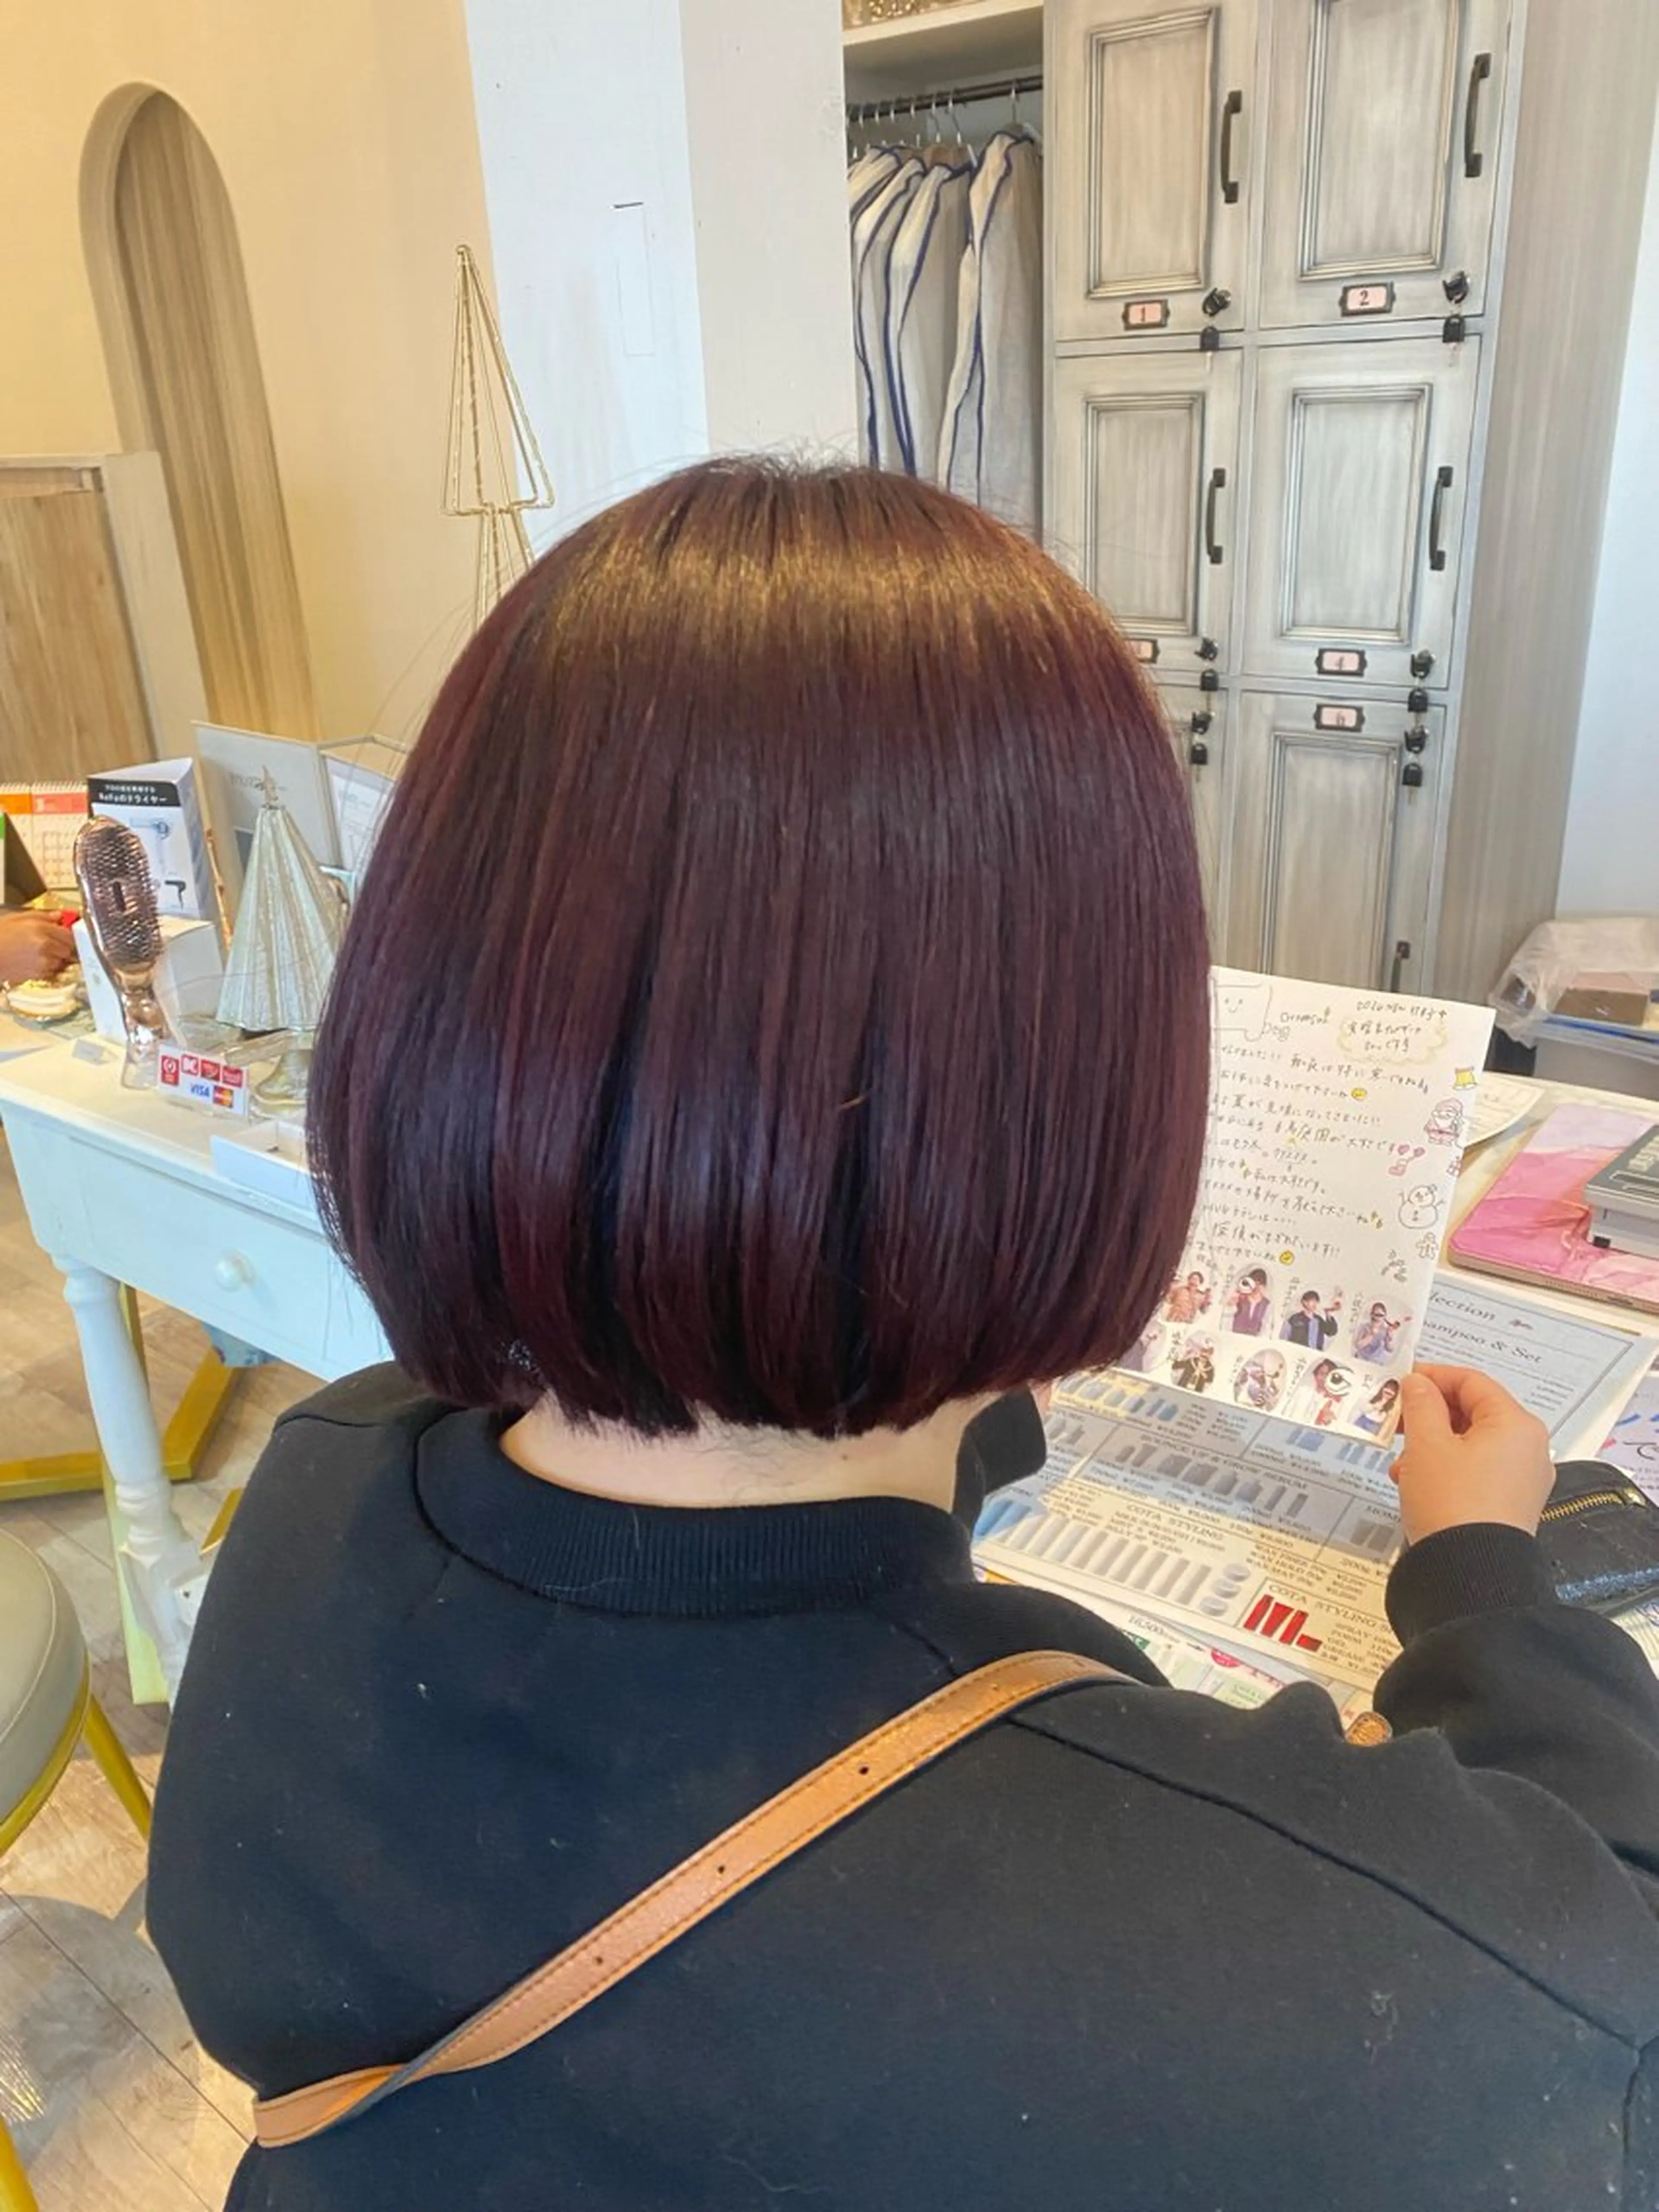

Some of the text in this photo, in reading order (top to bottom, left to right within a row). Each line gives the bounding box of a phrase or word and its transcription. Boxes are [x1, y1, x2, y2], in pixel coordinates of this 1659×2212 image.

[1360, 289, 1370, 306] 2
[1140, 306, 1146, 322] 1
[191, 1083, 210, 1097] VISA
[1423, 1319, 1542, 1363] ampoo & Set
[1126, 1504, 1161, 1522] COTA
[1169, 1517, 1225, 1541] STYLING
[1268, 1584, 1377, 1628] COTA STYLING
